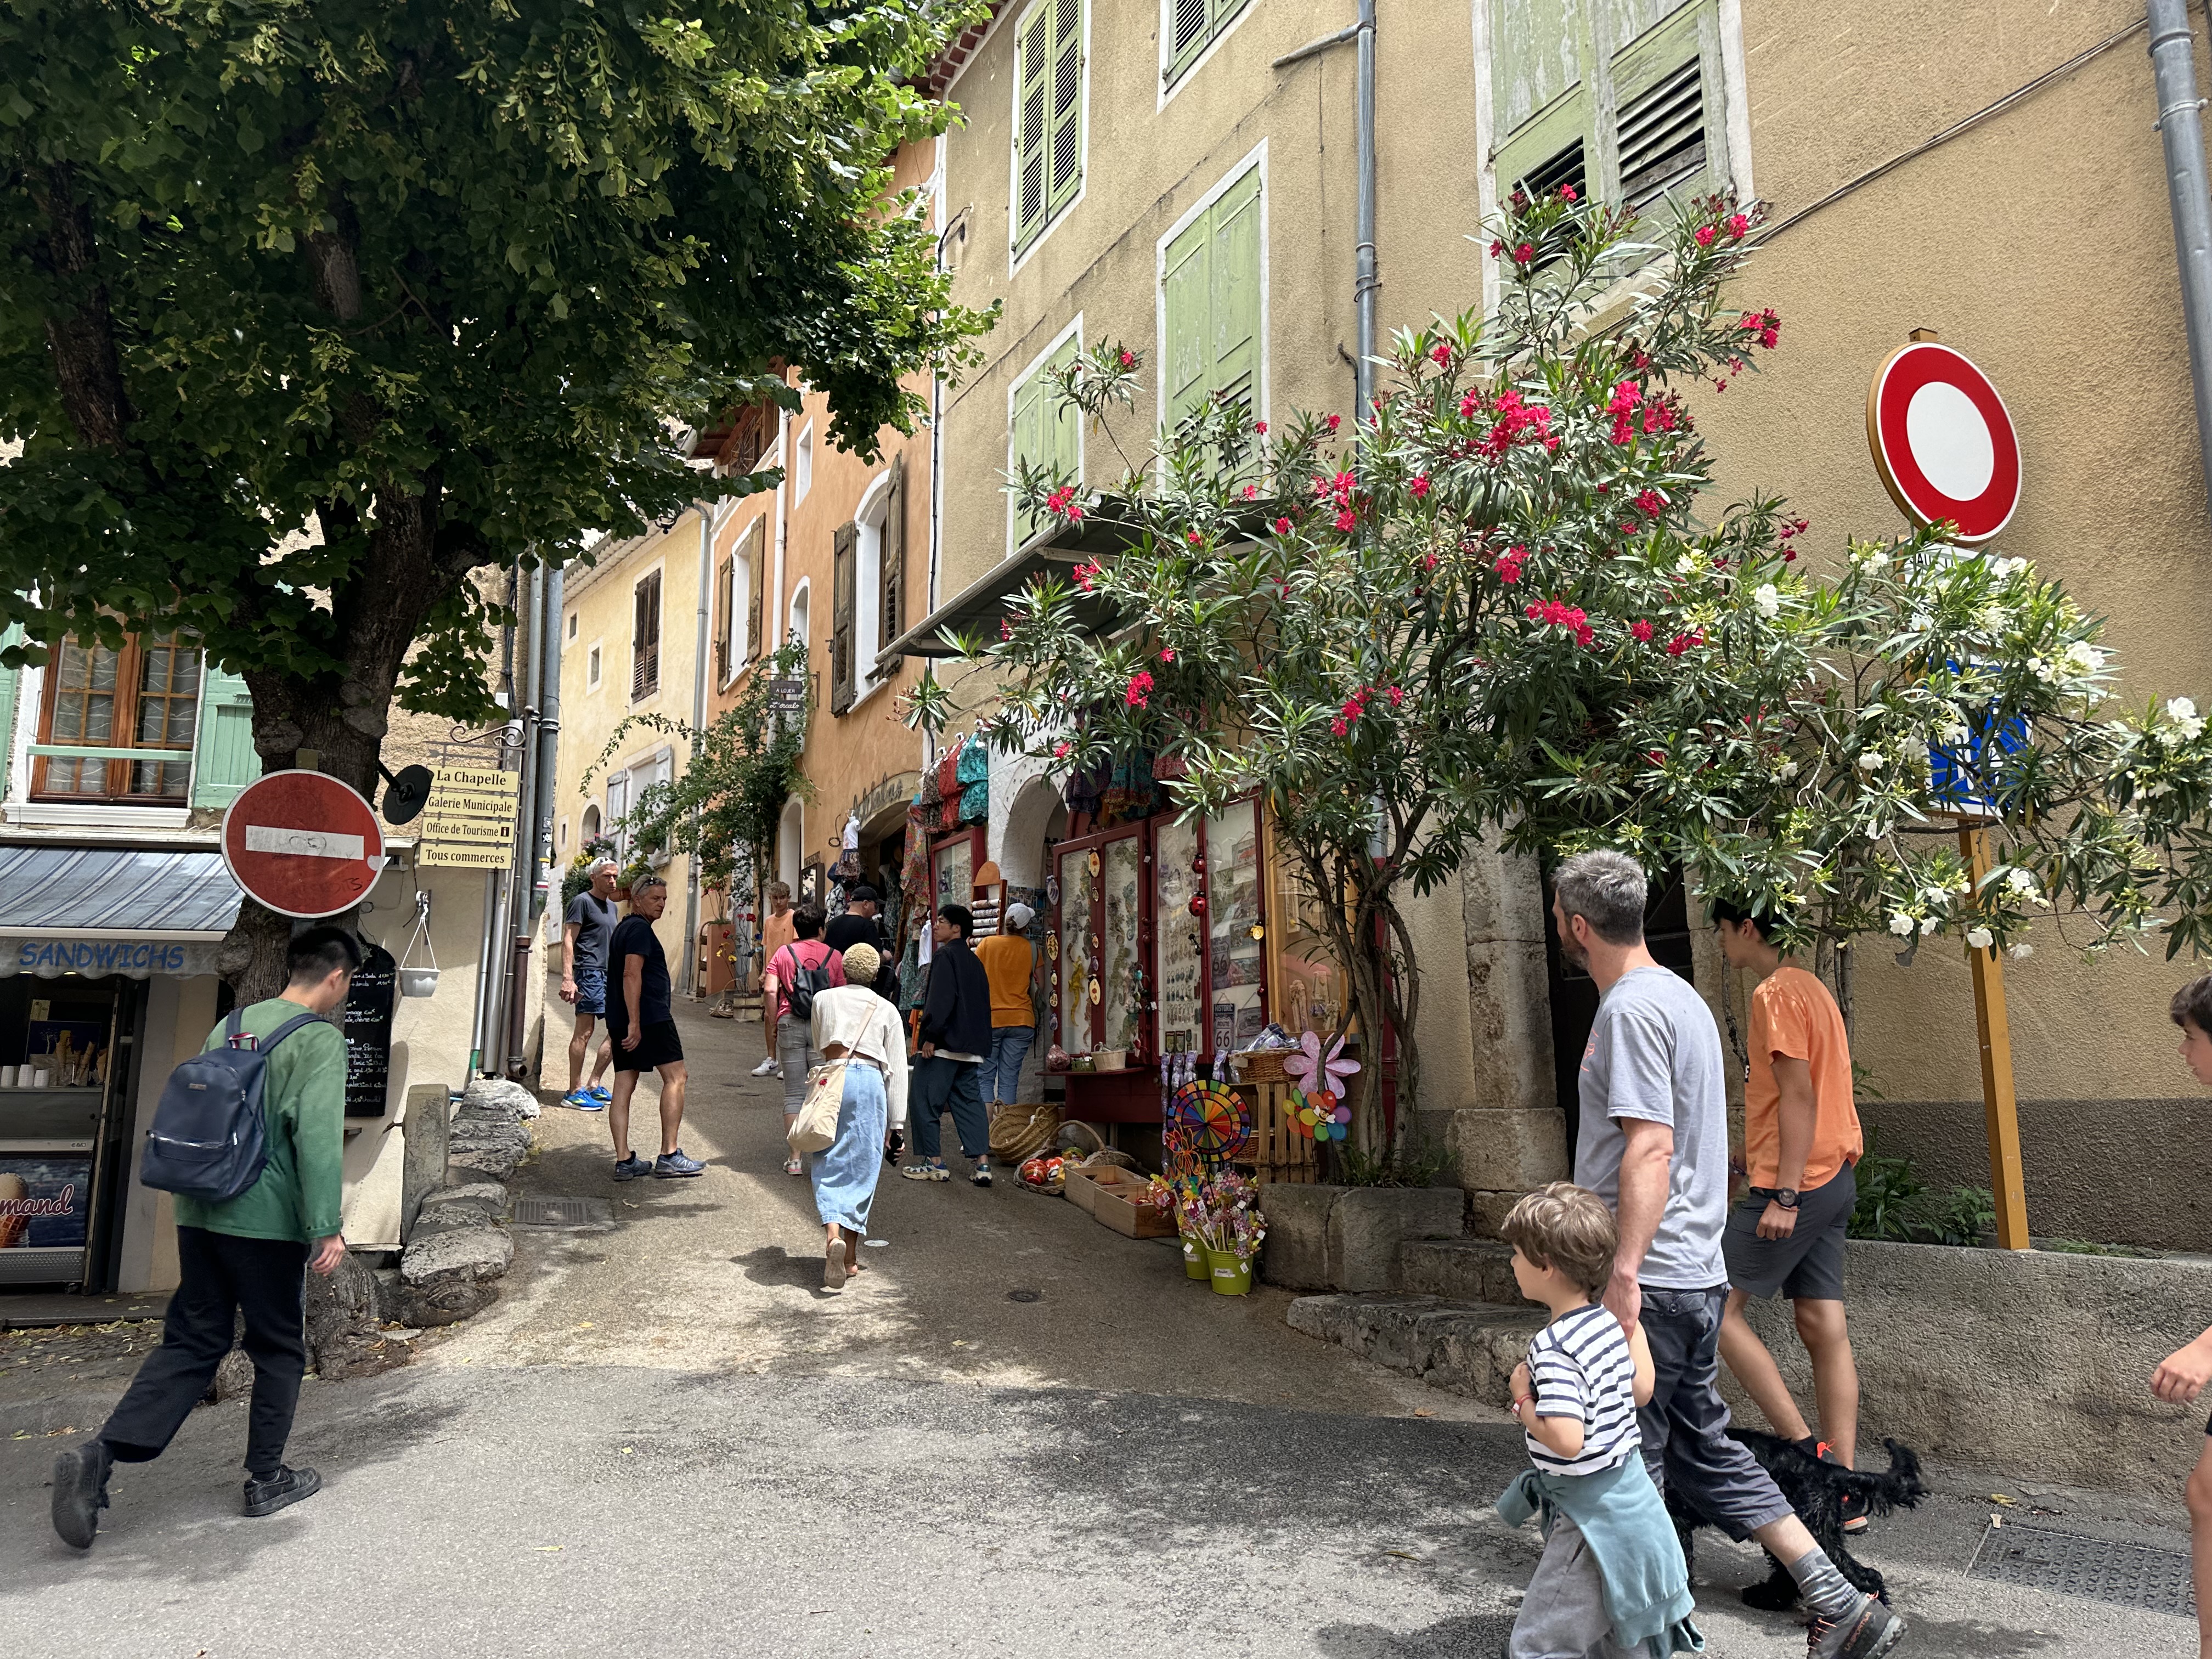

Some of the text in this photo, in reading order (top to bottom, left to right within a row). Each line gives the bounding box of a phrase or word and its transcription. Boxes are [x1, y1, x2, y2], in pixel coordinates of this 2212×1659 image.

[437, 770, 506, 786] La Chapelle
[428, 796, 512, 814] Galerie Municipale
[427, 822, 449, 833] Office
[450, 823, 460, 834] de
[462, 825, 498, 837] Tourisme
[426, 849, 504, 864] Tous commerces
[19, 942, 185, 969] SANDWICHS
[1212, 954, 1227, 972] 66
[1216, 1030, 1229, 1047] 66
